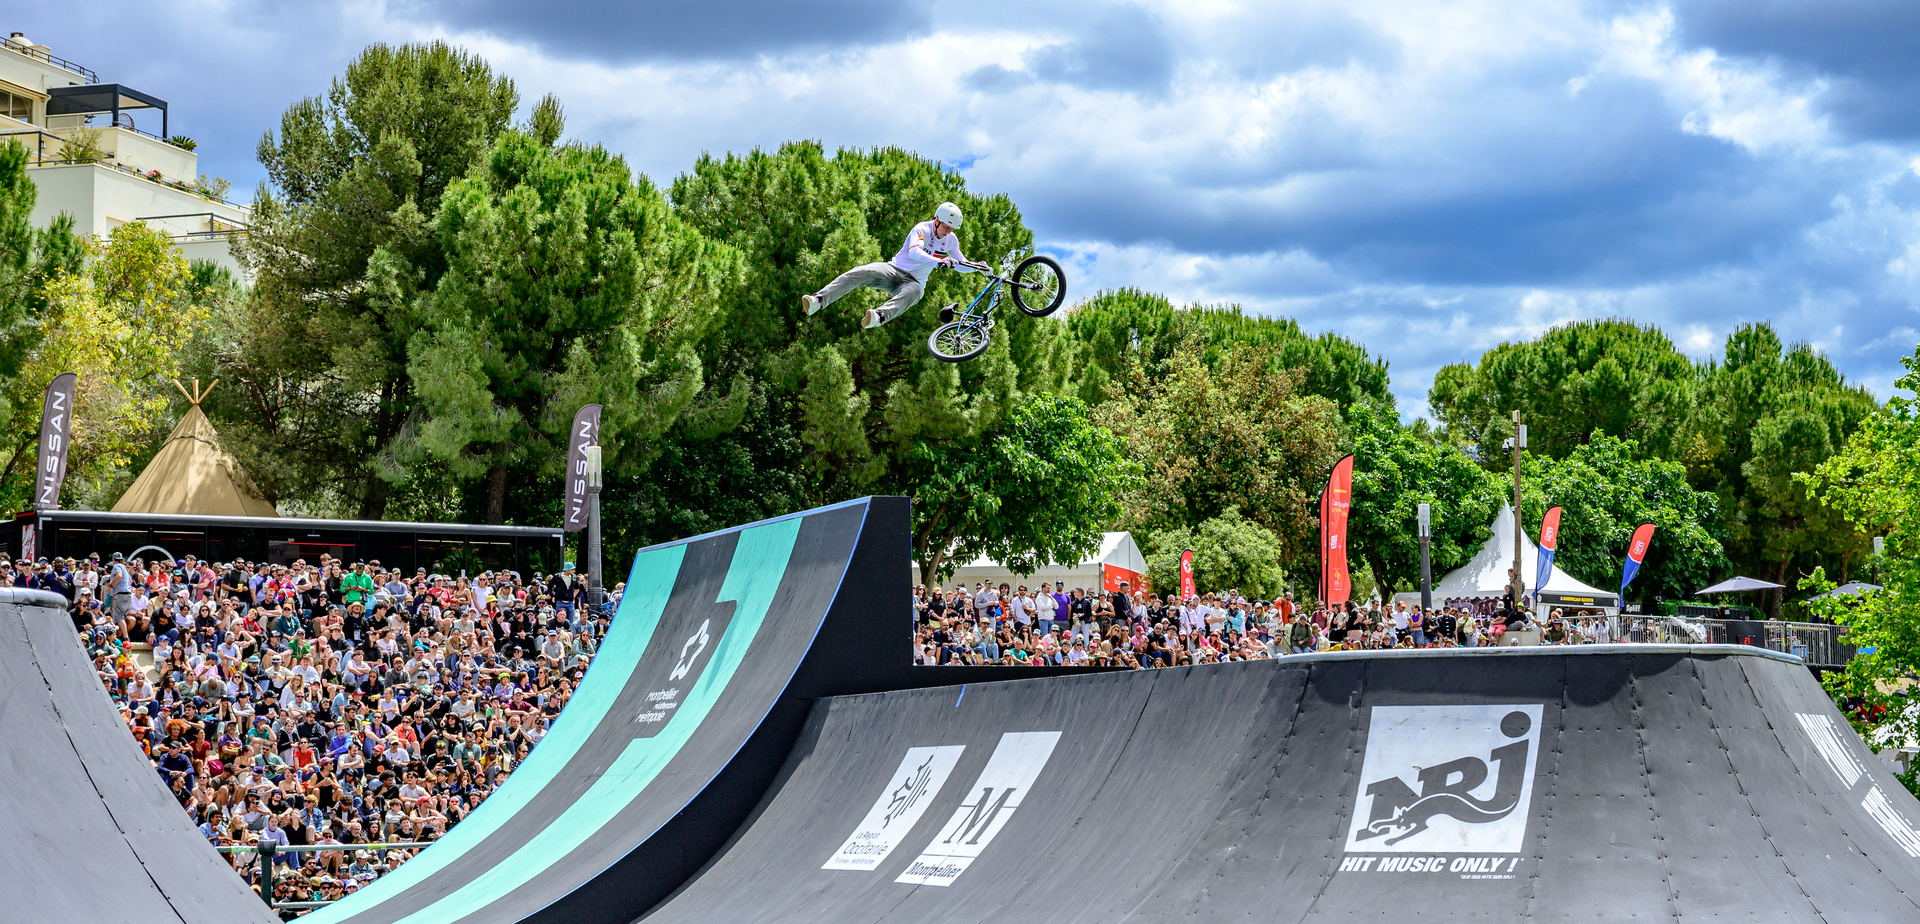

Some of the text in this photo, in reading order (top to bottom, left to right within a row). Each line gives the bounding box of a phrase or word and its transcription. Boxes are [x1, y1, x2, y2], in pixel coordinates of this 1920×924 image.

[40, 391, 66, 504] NISSAN
[570, 420, 593, 524] NISSAN
[645, 688, 680, 702] Montpellier
[634, 710, 666, 724] Métropole
[942, 787, 1017, 845] M
[843, 841, 888, 856] Occitanie
[906, 861, 963, 879] Montpellier
[1338, 857, 1376, 873] HIT
[1377, 857, 1447, 873] MUSIC
[1449, 857, 1506, 873] ONLY
